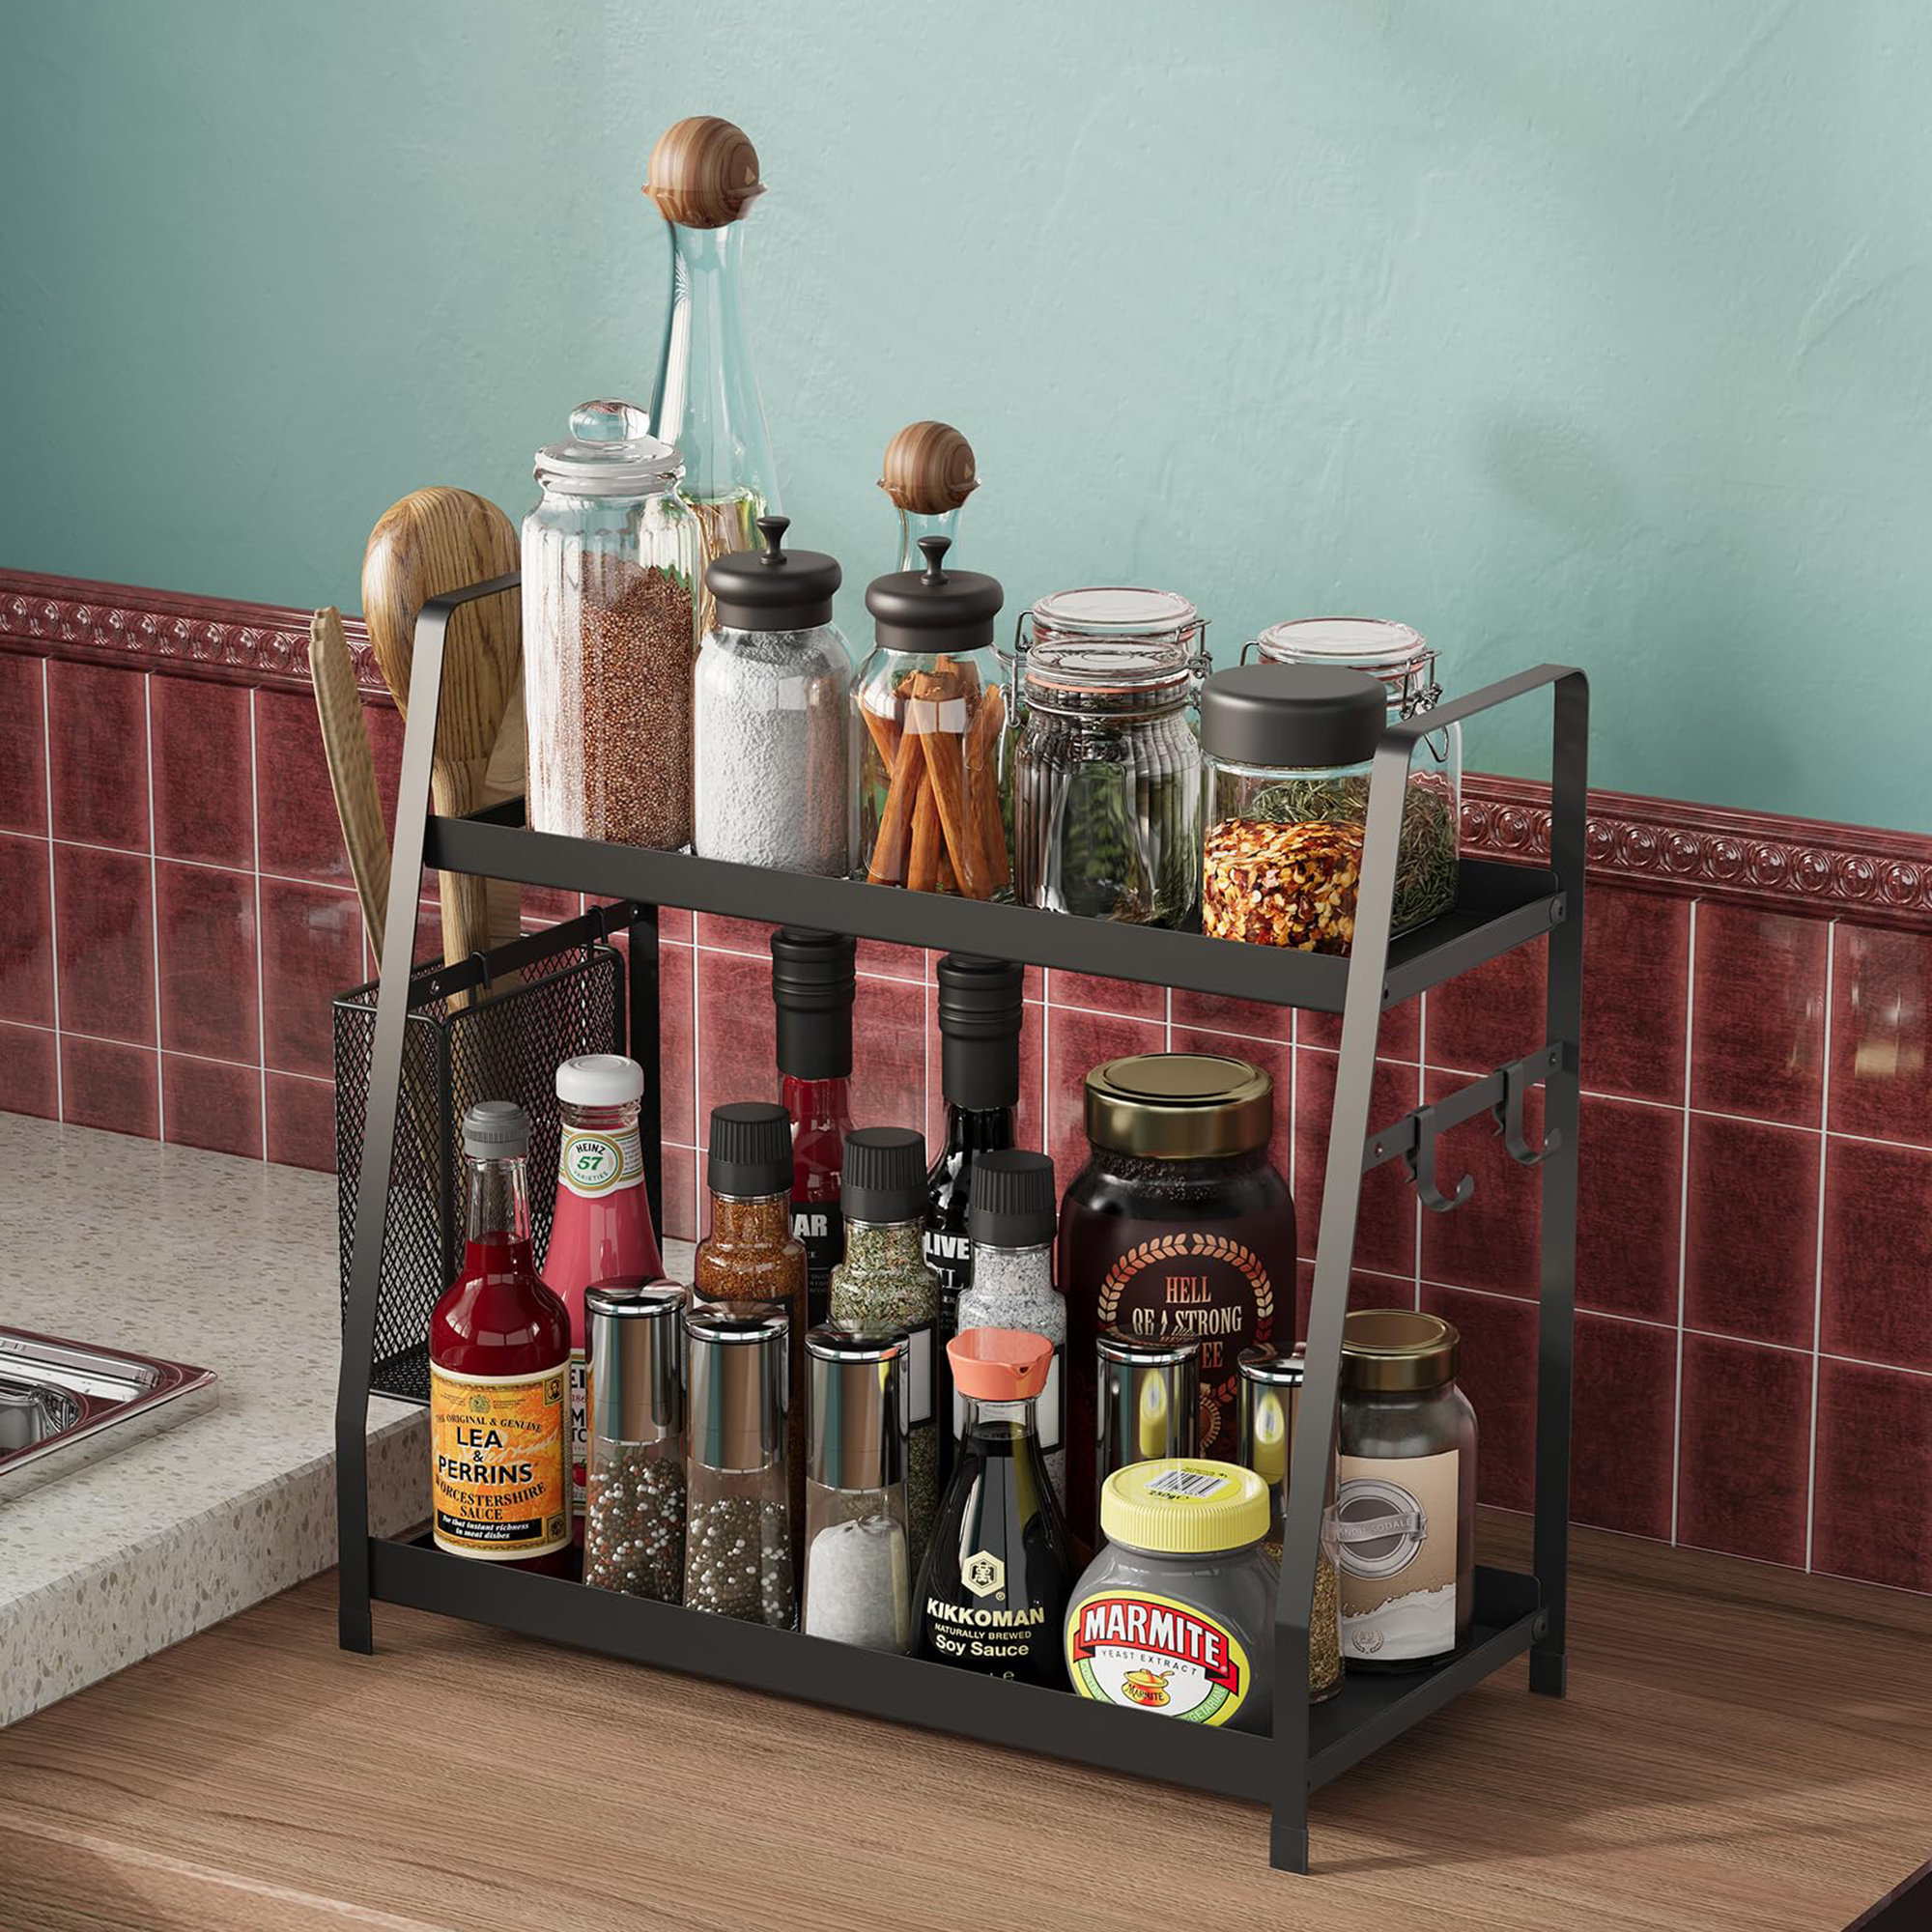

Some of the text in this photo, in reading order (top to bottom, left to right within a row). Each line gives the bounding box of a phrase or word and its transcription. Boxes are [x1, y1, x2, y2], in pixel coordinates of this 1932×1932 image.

[576, 1143, 606, 1155] HEINZ
[577, 1156, 604, 1171] 57
[923, 1231, 970, 1260] LIVE
[1165, 1276, 1212, 1303] HELL
[1175, 1306, 1242, 1336] STRONG
[446, 1414, 487, 1425] ORIGINAL
[500, 1419, 542, 1434] GENUINE
[457, 1426, 503, 1449] LEA
[473, 1450, 484, 1463] &
[439, 1455, 534, 1485] PERRINS
[460, 1505, 503, 1520] SAUCE
[467, 1521, 495, 1531] instant
[496, 1522, 529, 1531] richness
[926, 1597, 1044, 1628] KIKKOMAN
[934, 1623, 1032, 1640] NATURALLY BREWED
[1084, 1604, 1221, 1666] MARMITE
[936, 1634, 1030, 1657] Soy Sauce
[1101, 1649, 1198, 1676] YEAST EXTRACT
[1125, 1684, 1165, 1702] MARMITE
